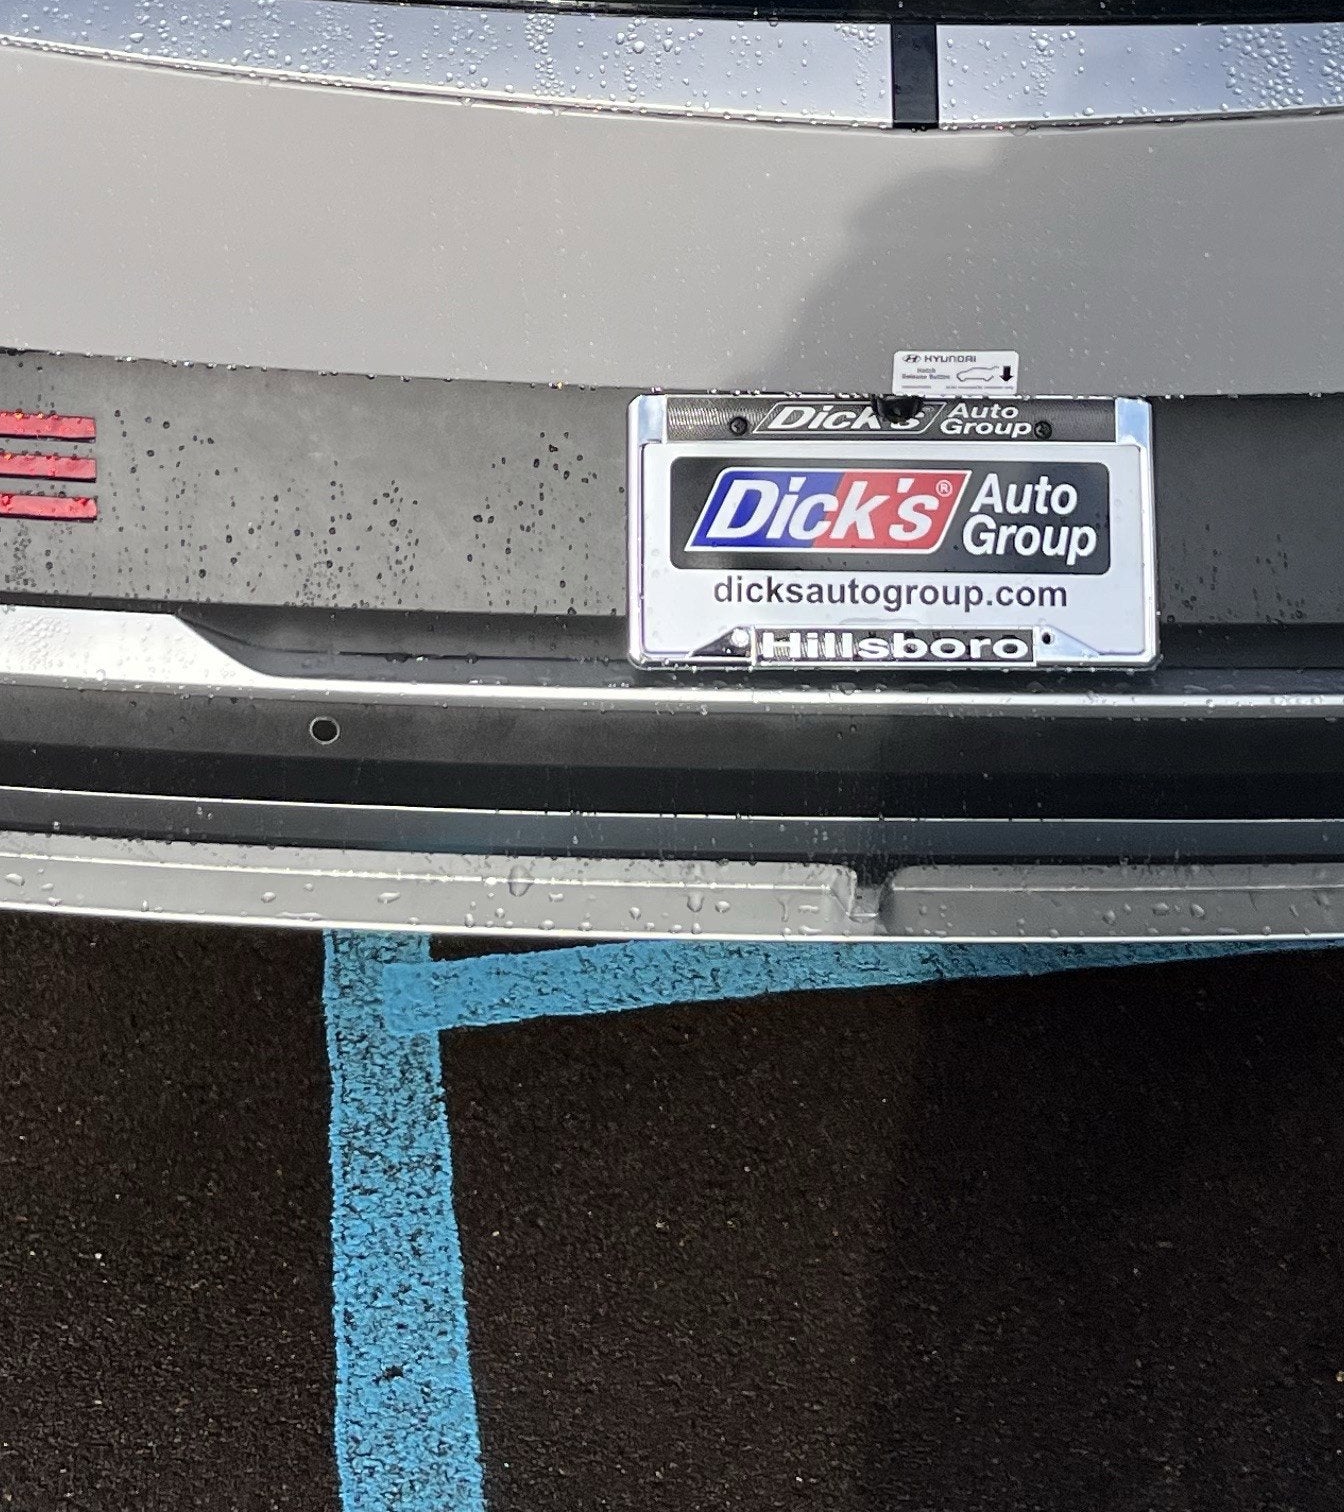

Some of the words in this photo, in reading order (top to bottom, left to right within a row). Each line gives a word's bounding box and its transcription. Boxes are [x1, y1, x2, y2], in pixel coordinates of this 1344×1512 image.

[924, 355, 977, 363] HYUNDAI
[767, 405, 924, 431] Dicks
[947, 403, 1019, 419] Auto
[940, 418, 1032, 438] Group
[706, 476, 940, 542] Dick's
[969, 473, 1079, 516] Auto
[962, 514, 1097, 565] Group
[713, 576, 1068, 614] dicksautogroup.com
[762, 631, 1029, 662] Hillsboro
